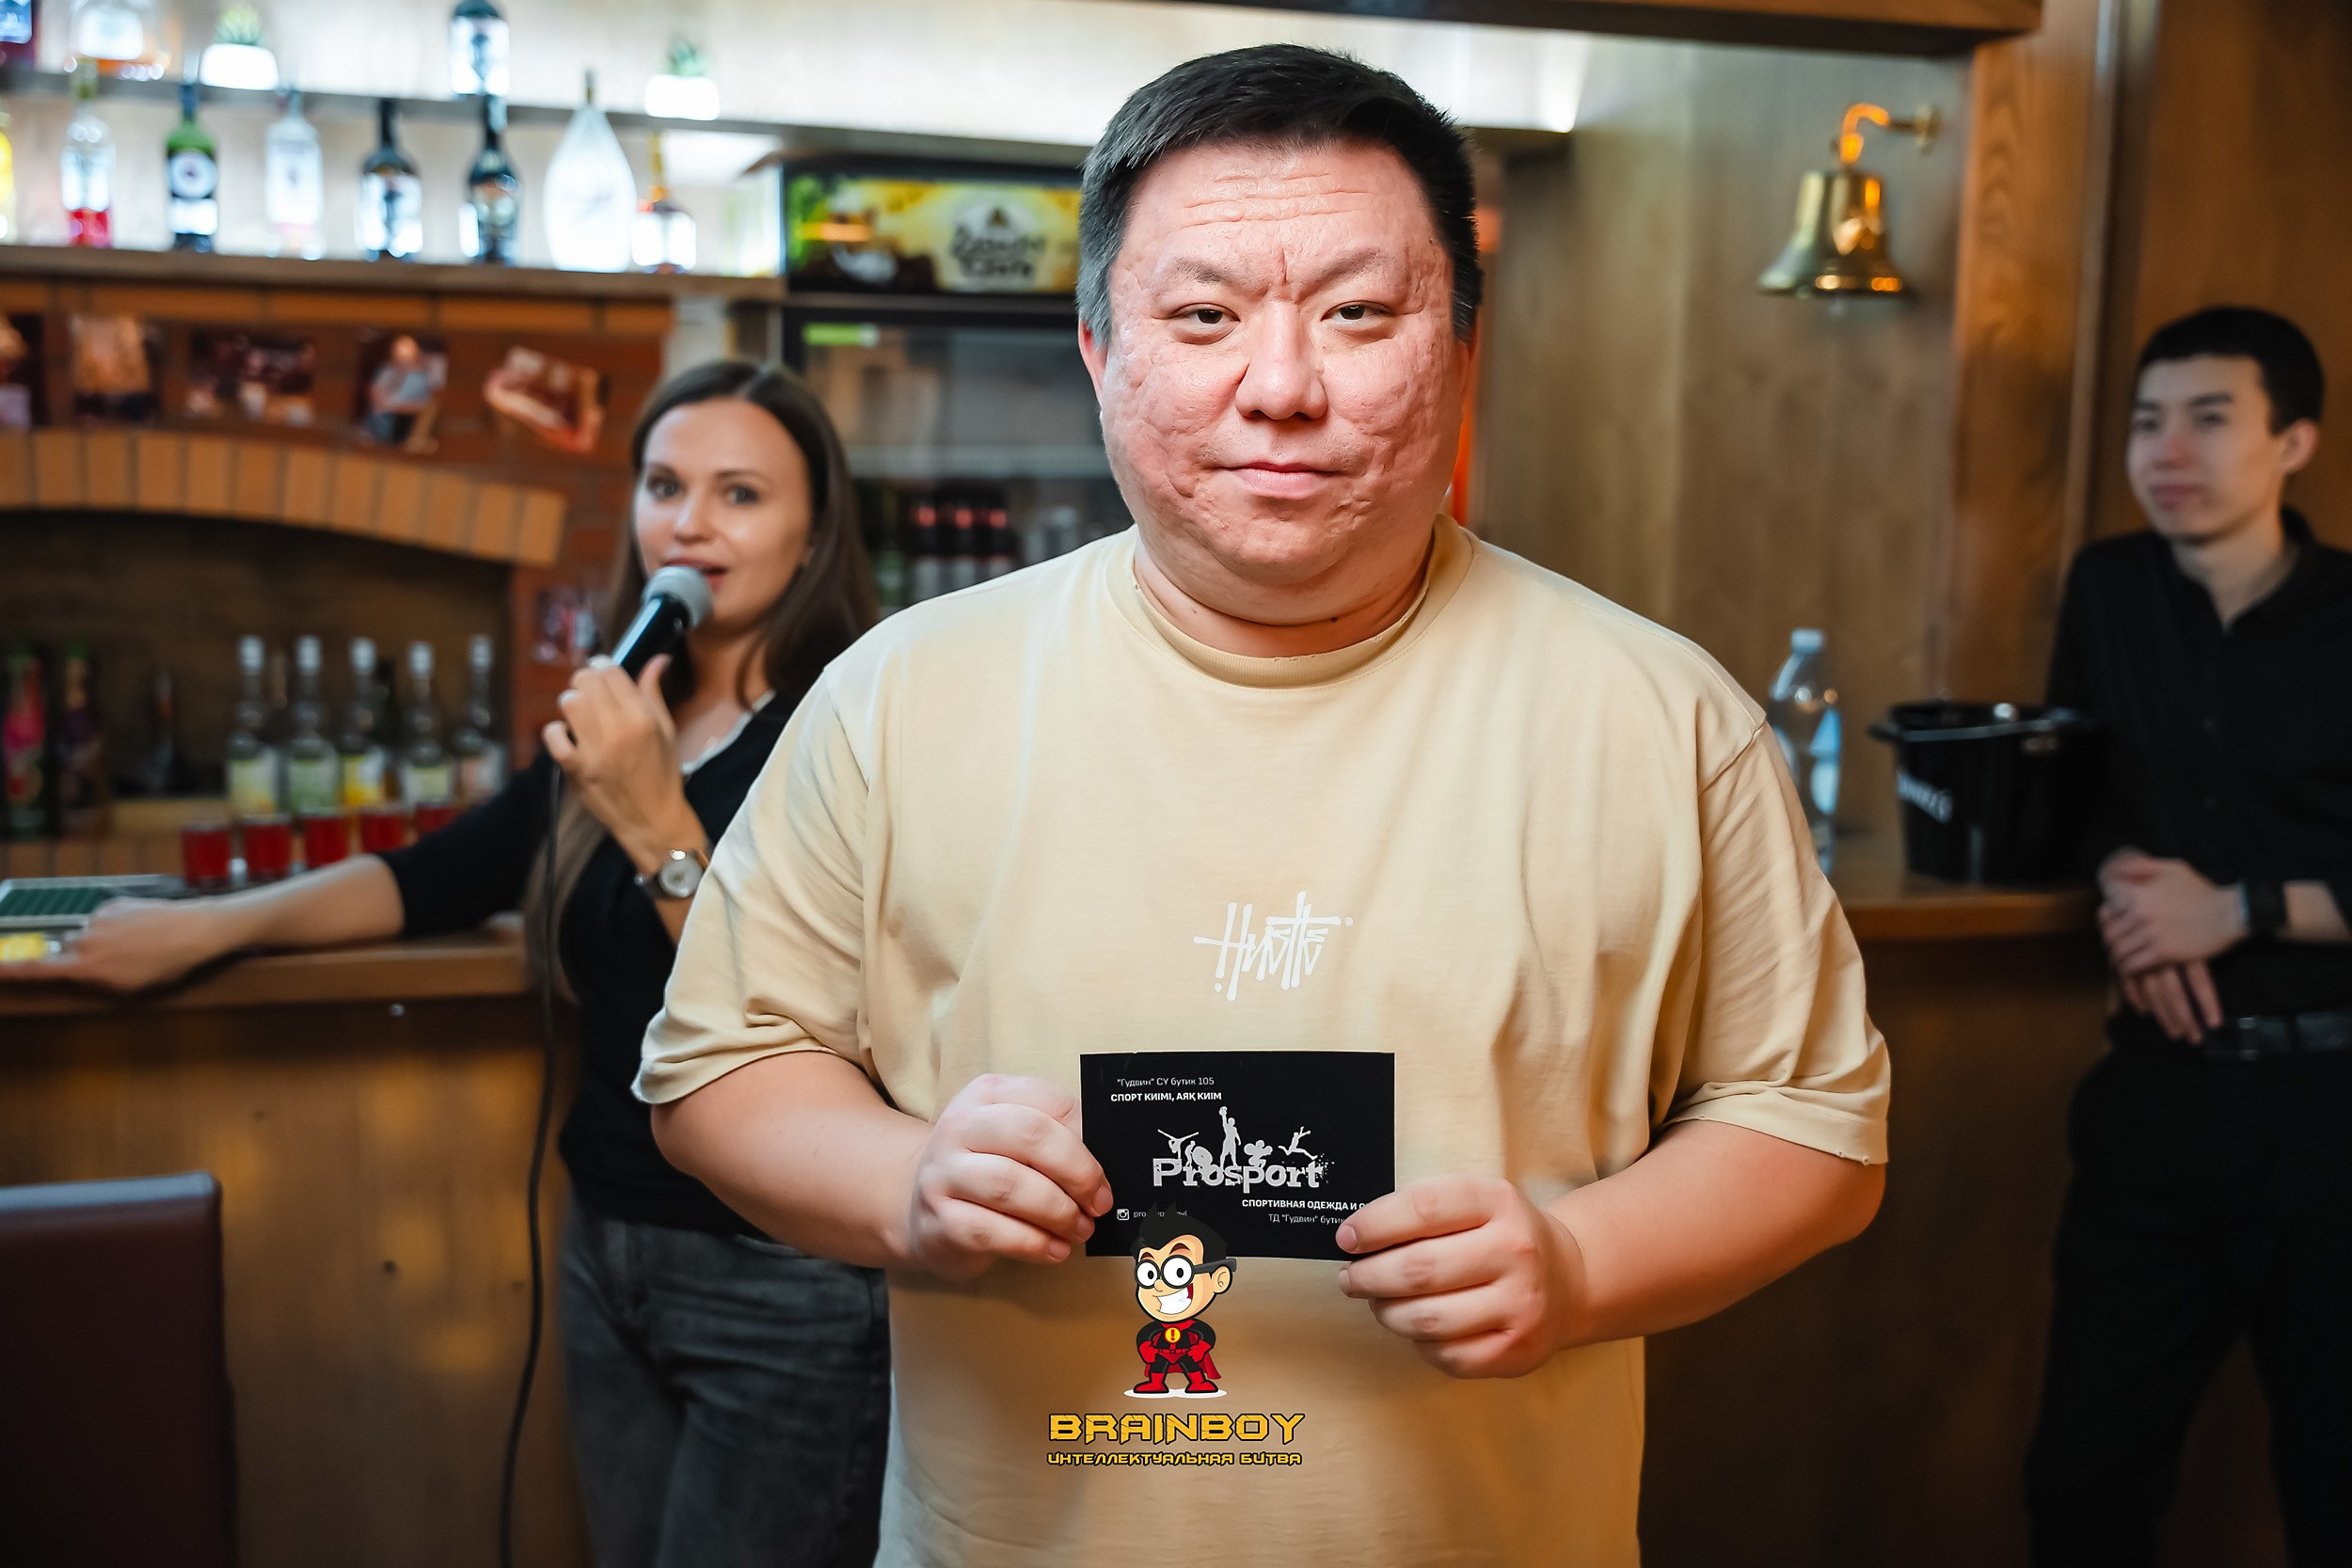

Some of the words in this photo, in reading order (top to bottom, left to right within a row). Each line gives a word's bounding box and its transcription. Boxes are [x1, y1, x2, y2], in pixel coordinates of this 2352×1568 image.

[1170, 1077, 1196, 1087] бутик
[1199, 1076, 1215, 1085] 105
[1110, 1093, 1143, 1102] СПОРТ
[1176, 1092, 1196, 1101] АЯҚ
[1152, 1158, 1324, 1194] Prosport
[1242, 1199, 1306, 1209] СПОРТИВНАЯ
[1307, 1200, 1349, 1211] ОДЕЖДА
[1350, 1202, 1358, 1211] И
[1267, 1213, 1280, 1223] ТД
[1281, 1214, 1318, 1224] "Гудвин"
